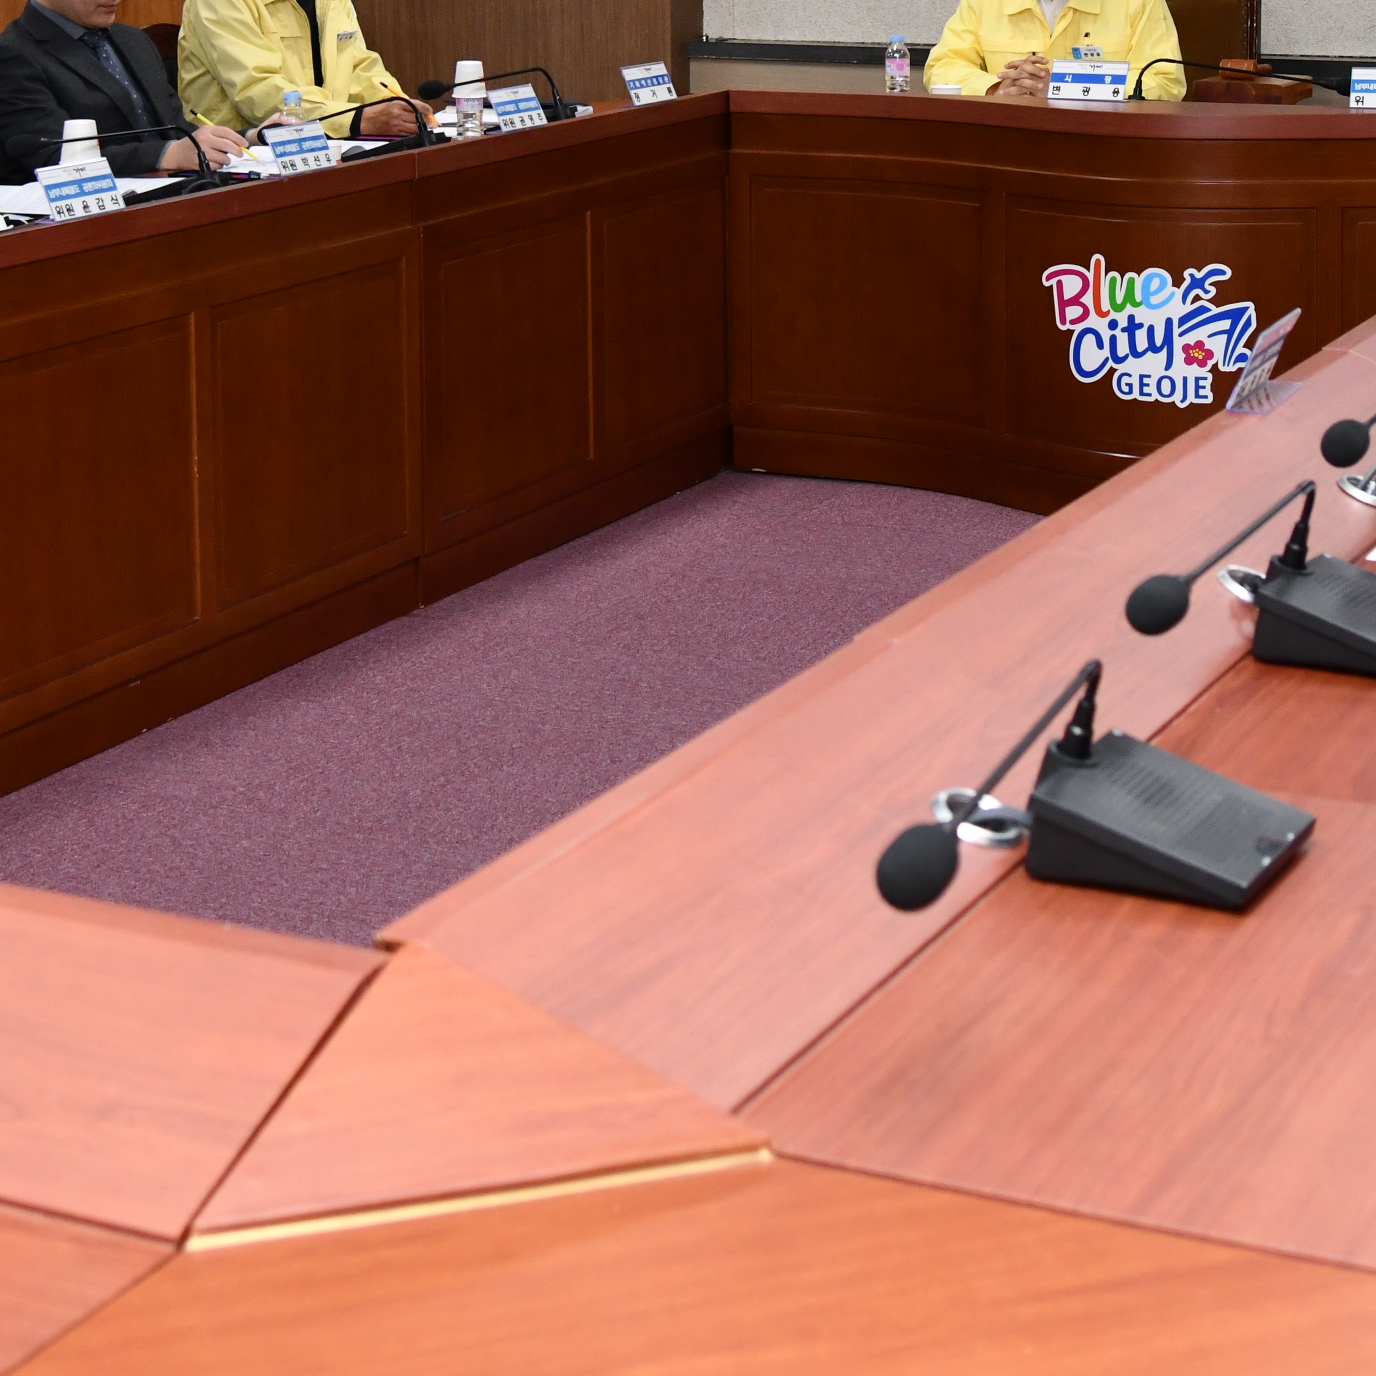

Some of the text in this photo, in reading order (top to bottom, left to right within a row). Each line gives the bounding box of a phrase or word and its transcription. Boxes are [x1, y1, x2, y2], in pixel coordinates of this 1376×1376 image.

[1045, 258, 1176, 326] Blue
[1073, 314, 1173, 378] City
[1116, 373, 1209, 403] GEOJE
